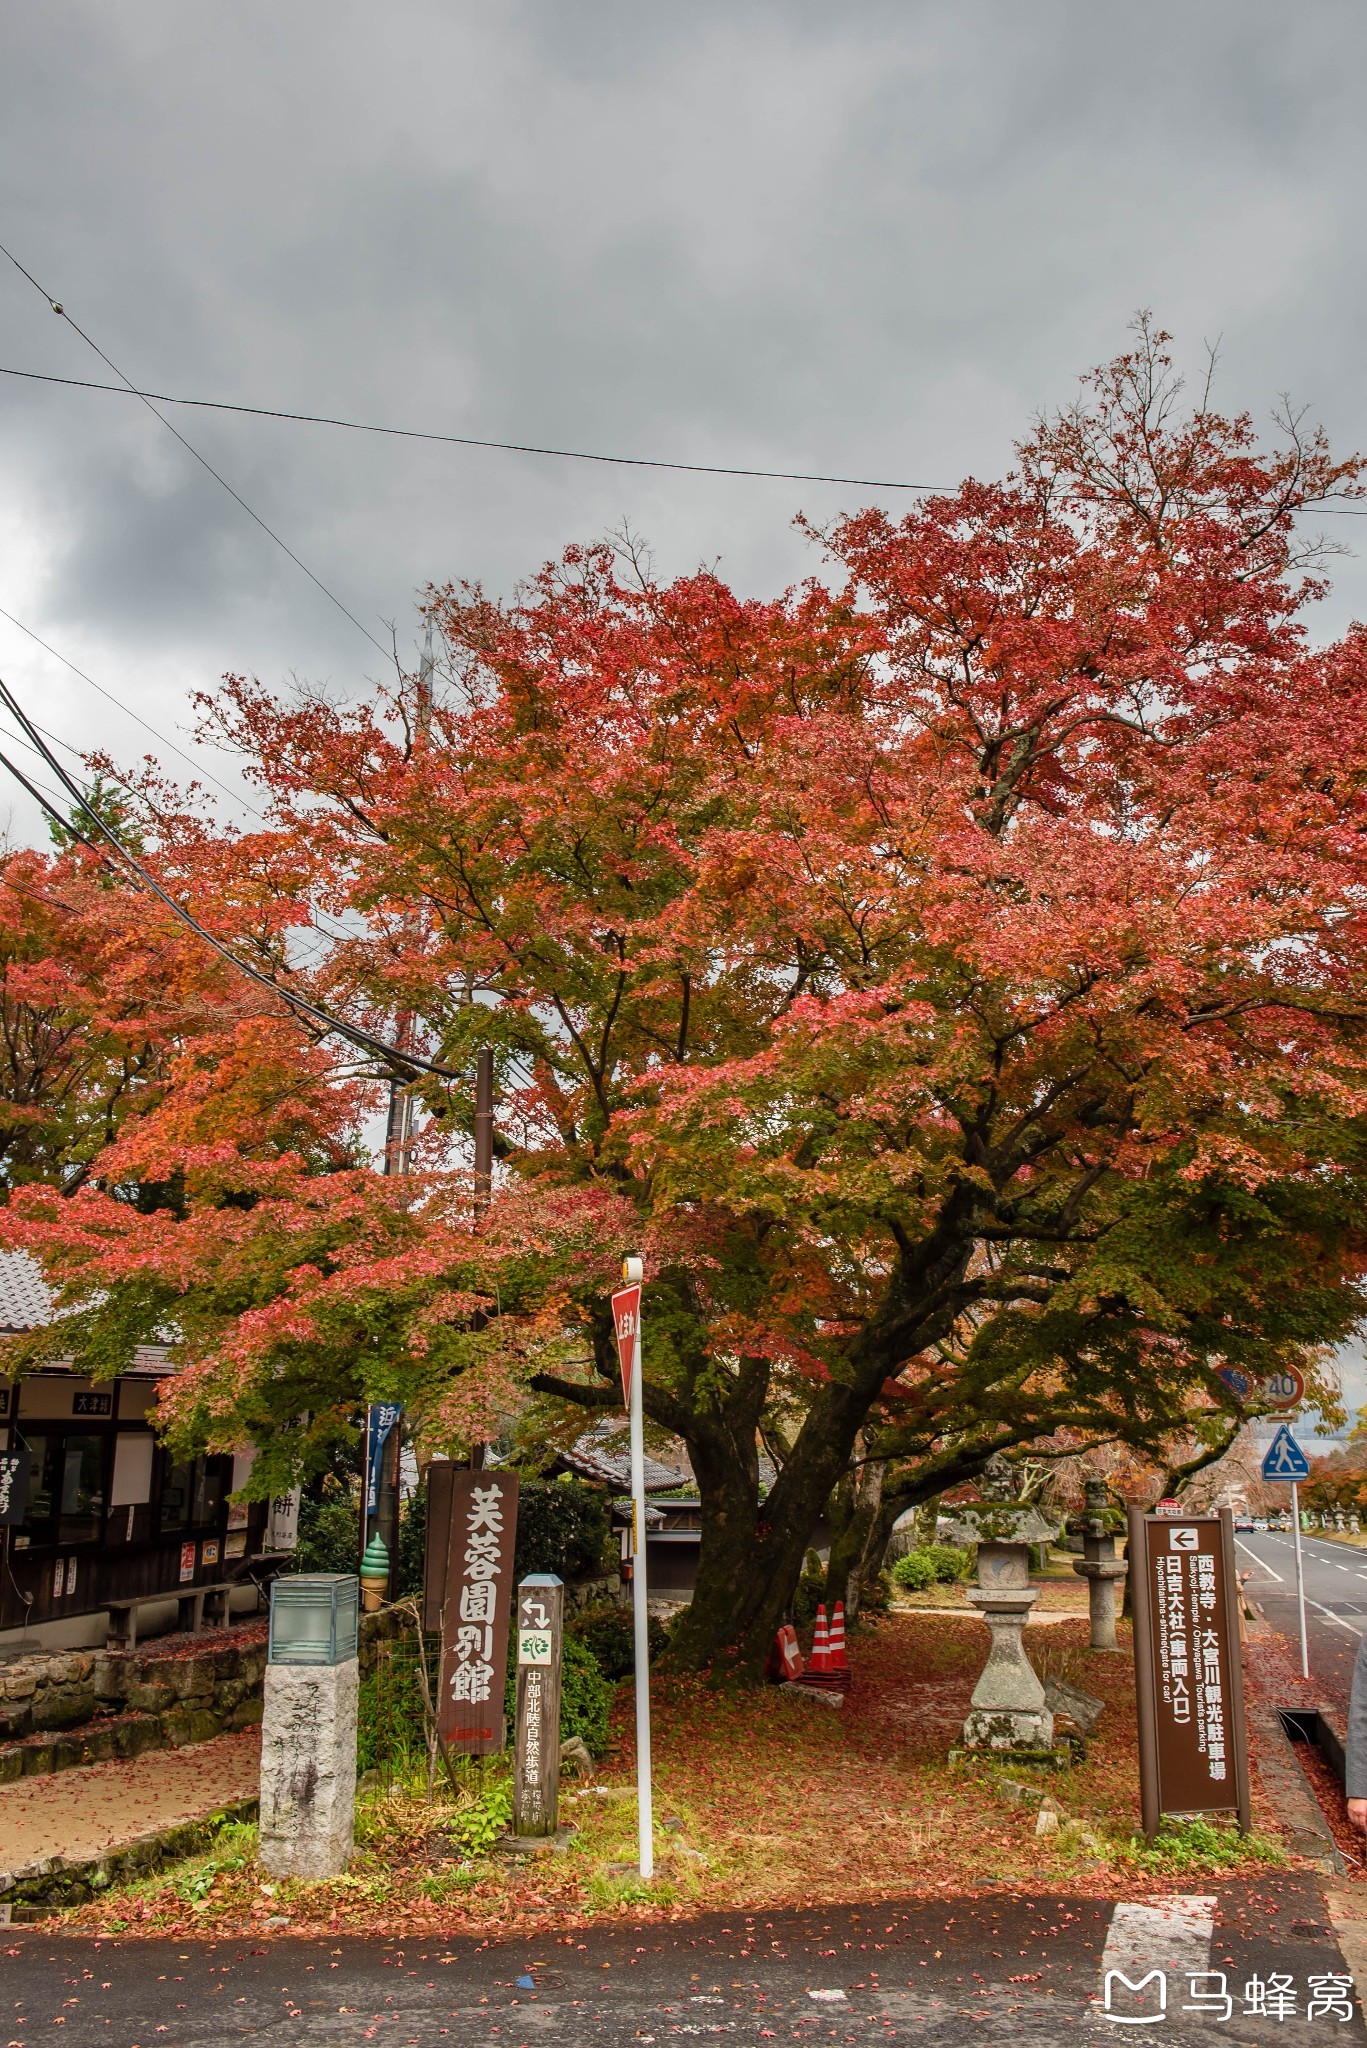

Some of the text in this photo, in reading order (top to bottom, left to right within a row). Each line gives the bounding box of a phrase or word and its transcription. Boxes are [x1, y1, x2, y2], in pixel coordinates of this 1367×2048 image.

[1269, 1374, 1295, 1396] 40
[450, 1483, 504, 1704] 芙蓉園別館
[1189, 1555, 1198, 1623] Saikyoji-temple
[1162, 1670, 1171, 1683] for
[1192, 1630, 1203, 1680] Omiyagawa
[1197, 1554, 1227, 1781] 西教寺・大宮川観光駐車場
[1163, 1685, 1173, 1703] car)
[525, 1671, 542, 1784] 中部北陸自然歩道
[1196, 1719, 1207, 1753] parking
